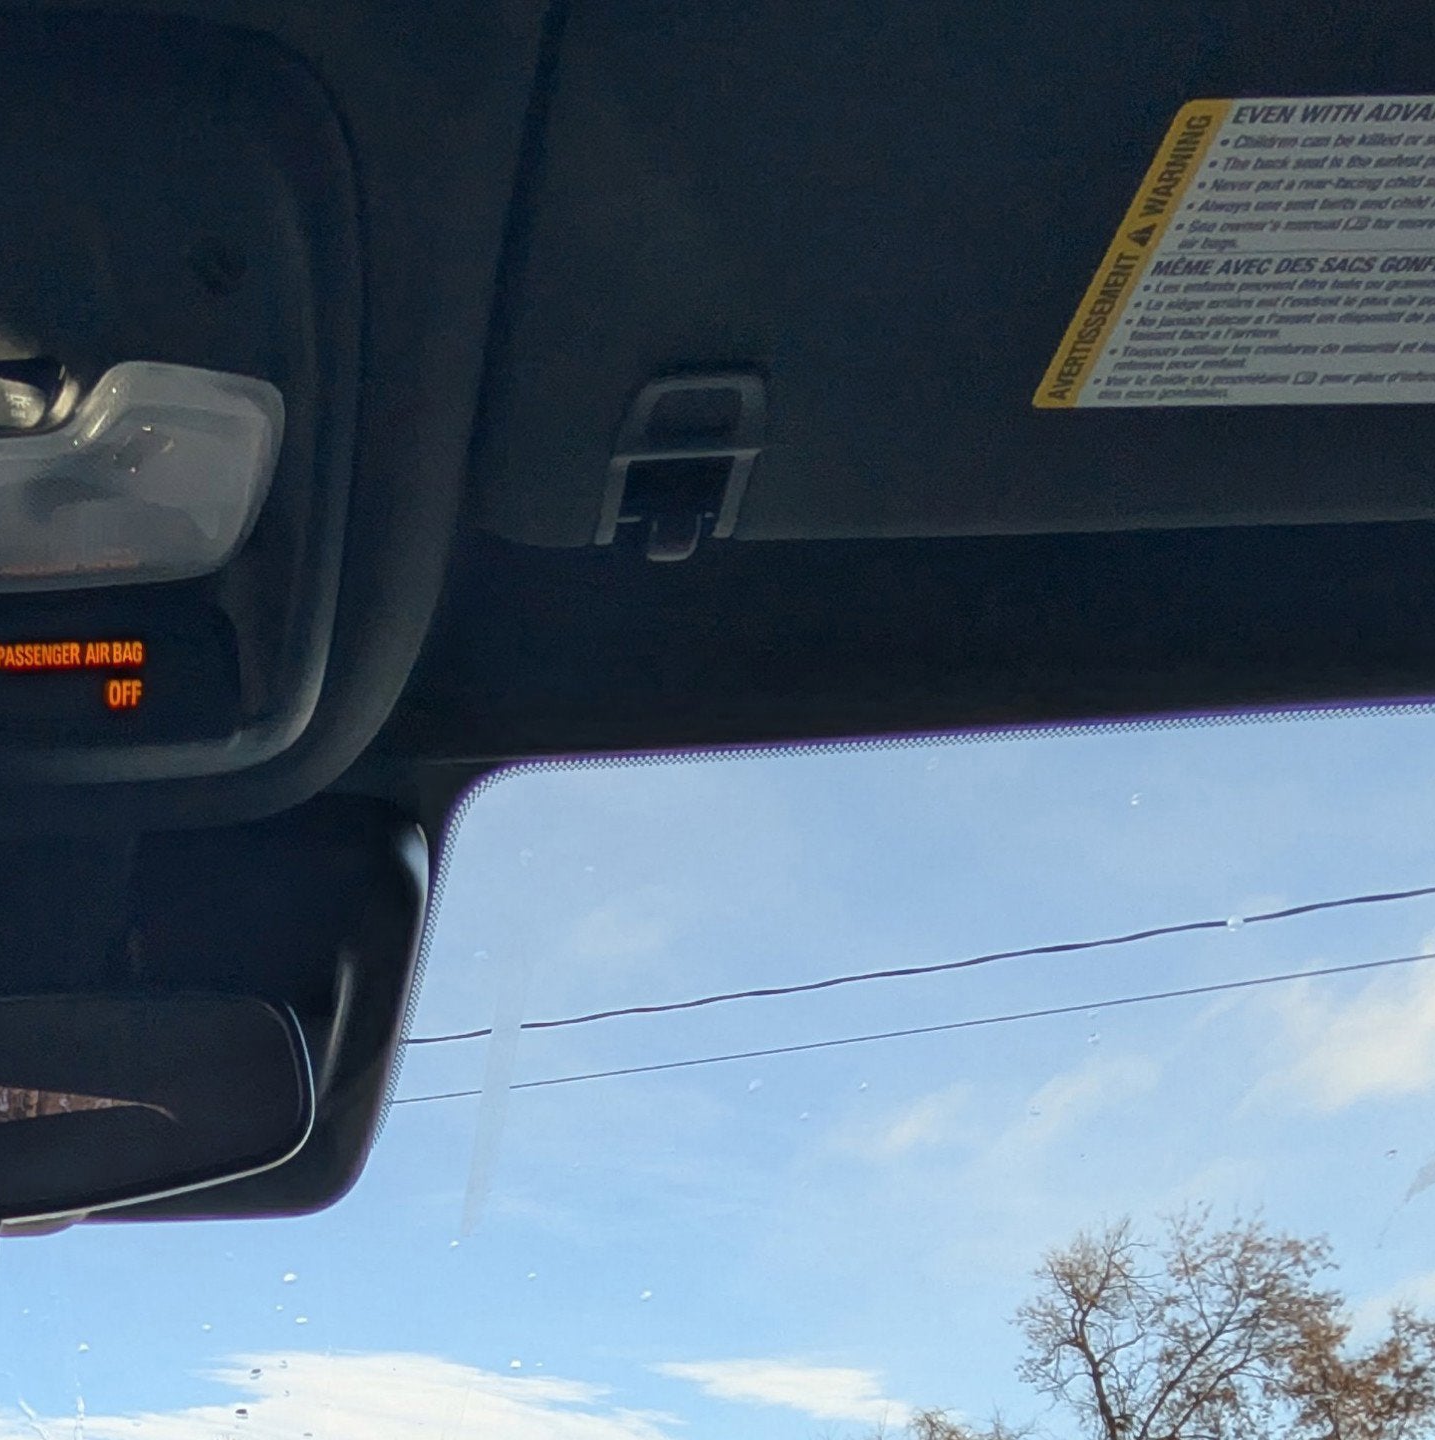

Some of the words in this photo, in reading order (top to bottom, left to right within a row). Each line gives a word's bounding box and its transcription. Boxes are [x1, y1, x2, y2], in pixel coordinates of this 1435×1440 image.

[1232, 105, 1297, 124] EVEN
[1300, 104, 1364, 123] WITH
[1140, 115, 1212, 218] WARNING
[1151, 257, 1215, 276] MÊME
[1216, 258, 1273, 275] AVEC
[1274, 258, 1319, 274] DES
[1320, 256, 1376, 273] SACS
[1048, 252, 1139, 400] AVERTISSEMENT
[85, 642, 110, 665] AIR
[112, 641, 143, 665] BAG
[108, 679, 142, 706] OFF
